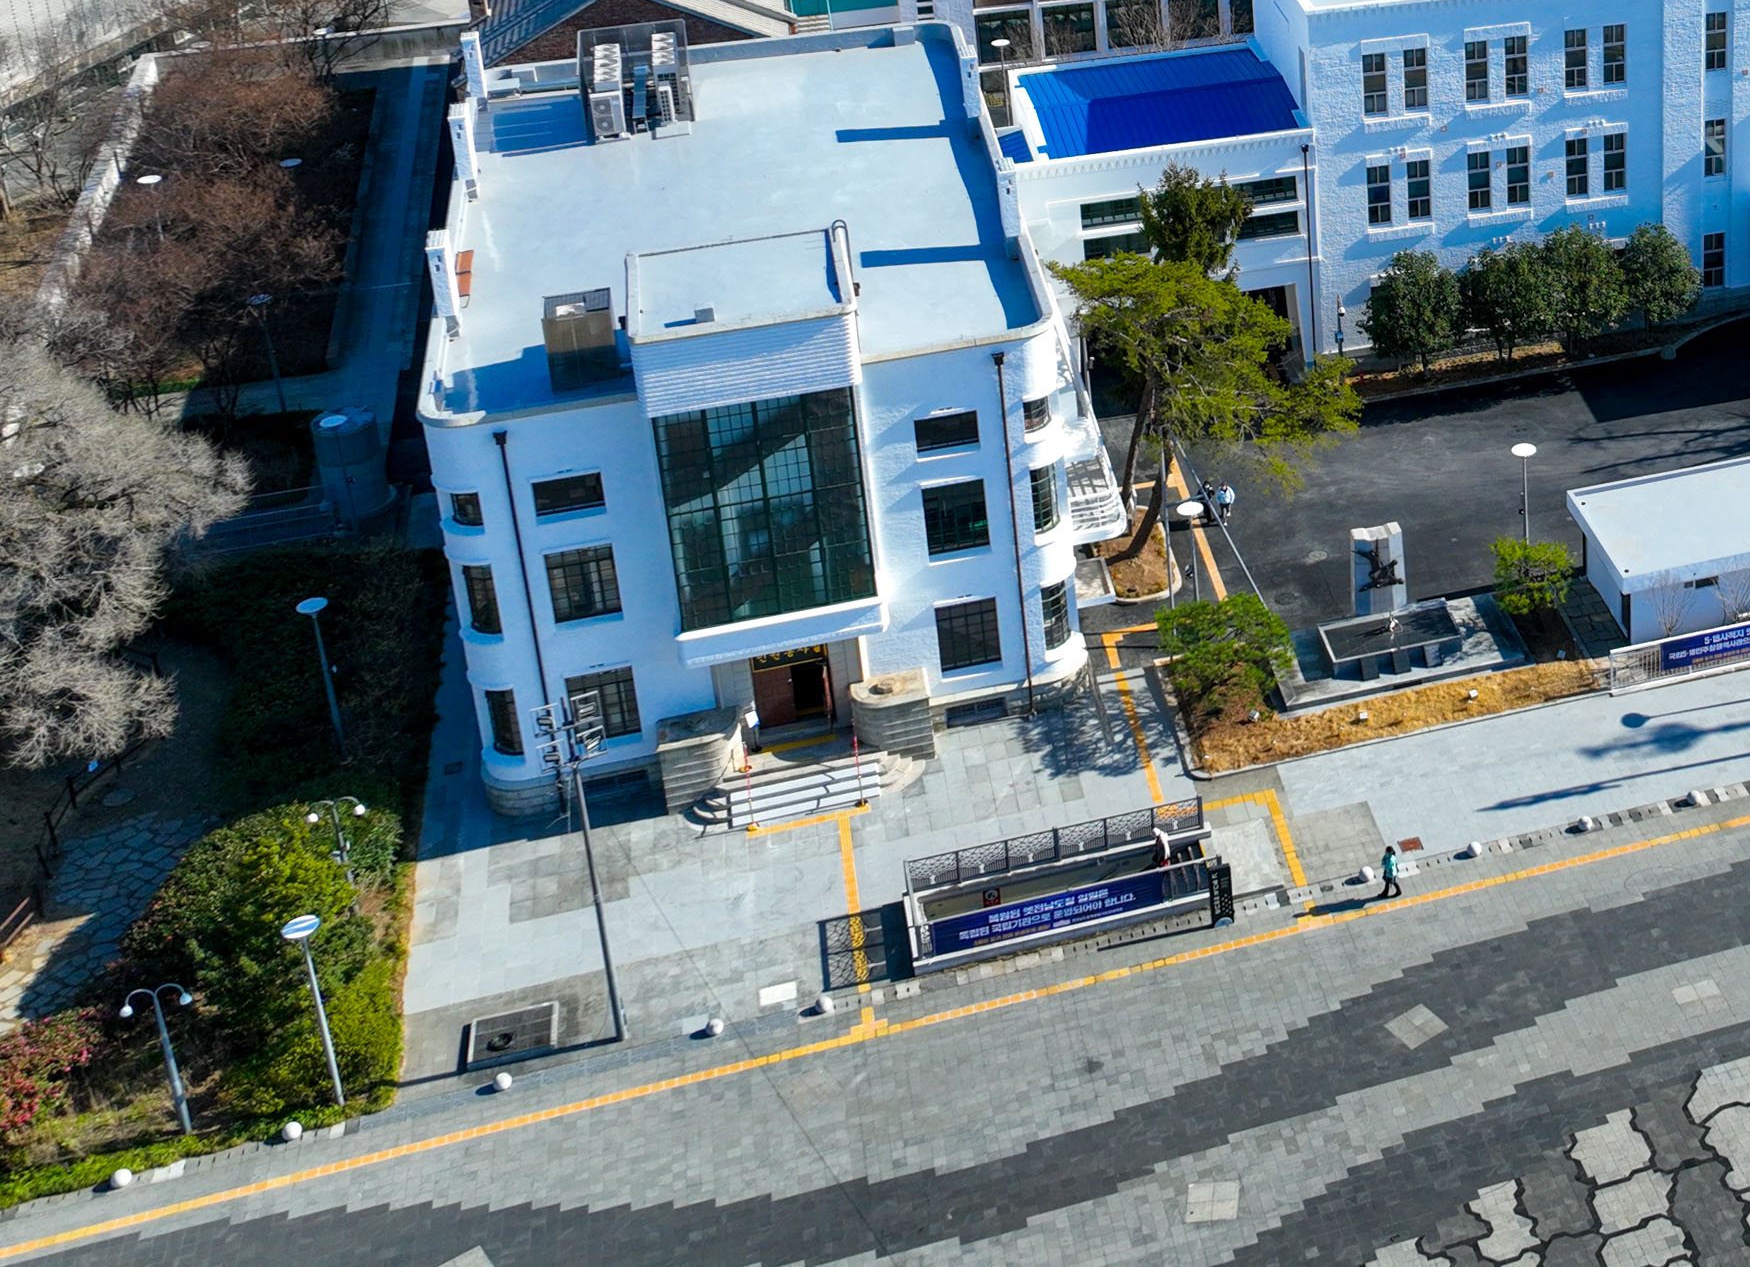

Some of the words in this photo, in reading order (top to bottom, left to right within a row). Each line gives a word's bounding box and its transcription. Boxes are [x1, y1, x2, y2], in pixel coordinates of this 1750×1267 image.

[959, 925, 990, 941] 독립된
[991, 912, 1051, 933] 국립기관으로
[1053, 901, 1102, 919] 운영되어야
[988, 907, 1021, 923] 복원된
[1022, 896, 1075, 918] 옛전남도청
[1078, 888, 1109, 903] 일원은
